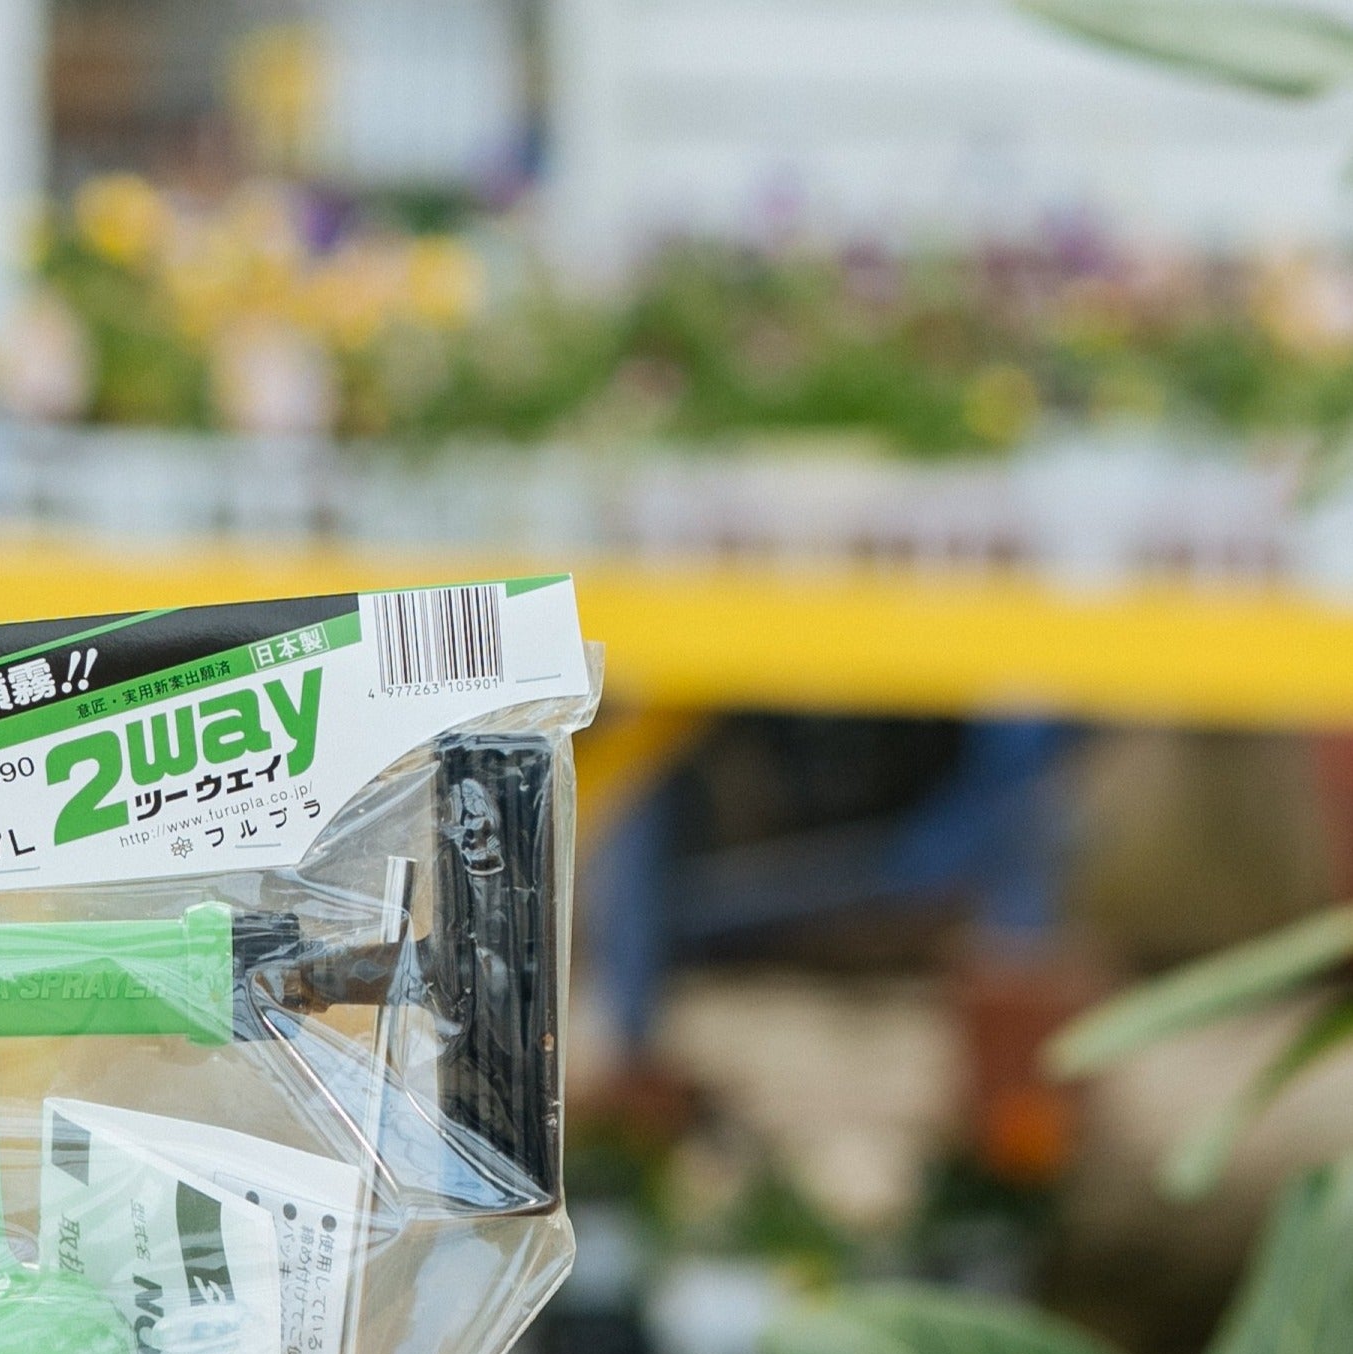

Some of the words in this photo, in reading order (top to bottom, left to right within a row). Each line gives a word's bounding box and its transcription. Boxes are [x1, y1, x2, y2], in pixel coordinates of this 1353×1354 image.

[256, 626, 326, 668] 日本製
[76, 660, 231, 720] 意匠・実用新案出願済
[368, 690, 375, 699] 4
[386, 683, 440, 698] 977263
[448, 678, 498, 693] 105901
[45, 666, 324, 847] 2way
[119, 781, 313, 849] http://www.furupla.co.jp/
